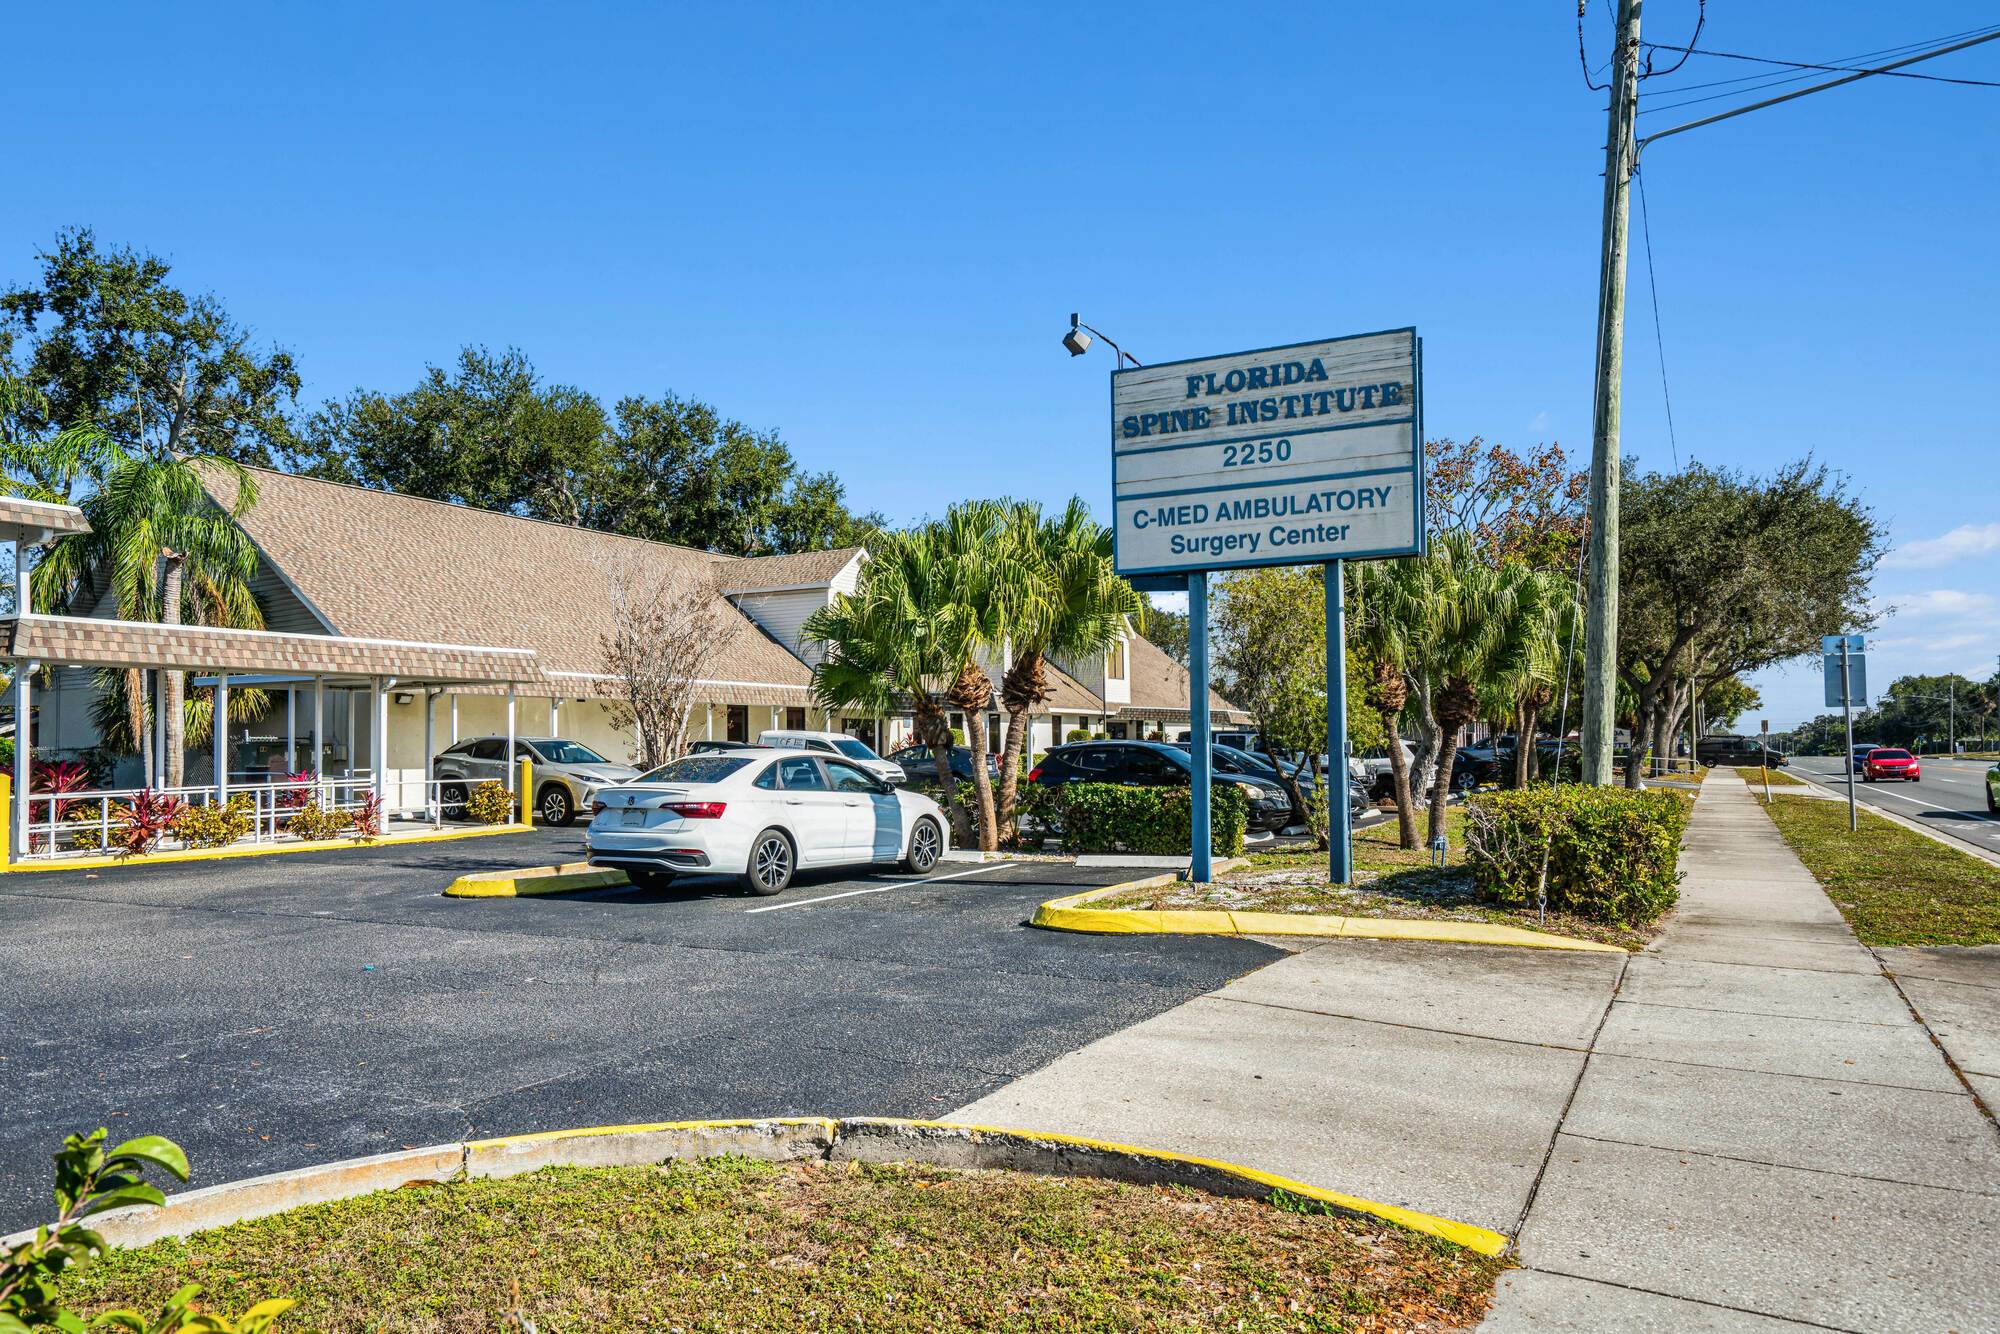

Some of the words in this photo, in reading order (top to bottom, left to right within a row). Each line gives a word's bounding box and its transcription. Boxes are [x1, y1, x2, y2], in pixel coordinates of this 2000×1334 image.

[1186, 358, 1328, 398] FLORIDA
[1122, 406, 1211, 438] SPINE
[1227, 381, 1402, 426] INSTITUTE
[1223, 439, 1291, 467] 2250
[1133, 504, 1209, 530] C-MED
[1216, 486, 1392, 522] AMBULATORY
[1170, 532, 1261, 556] Surgery
[1269, 524, 1350, 546] Center
